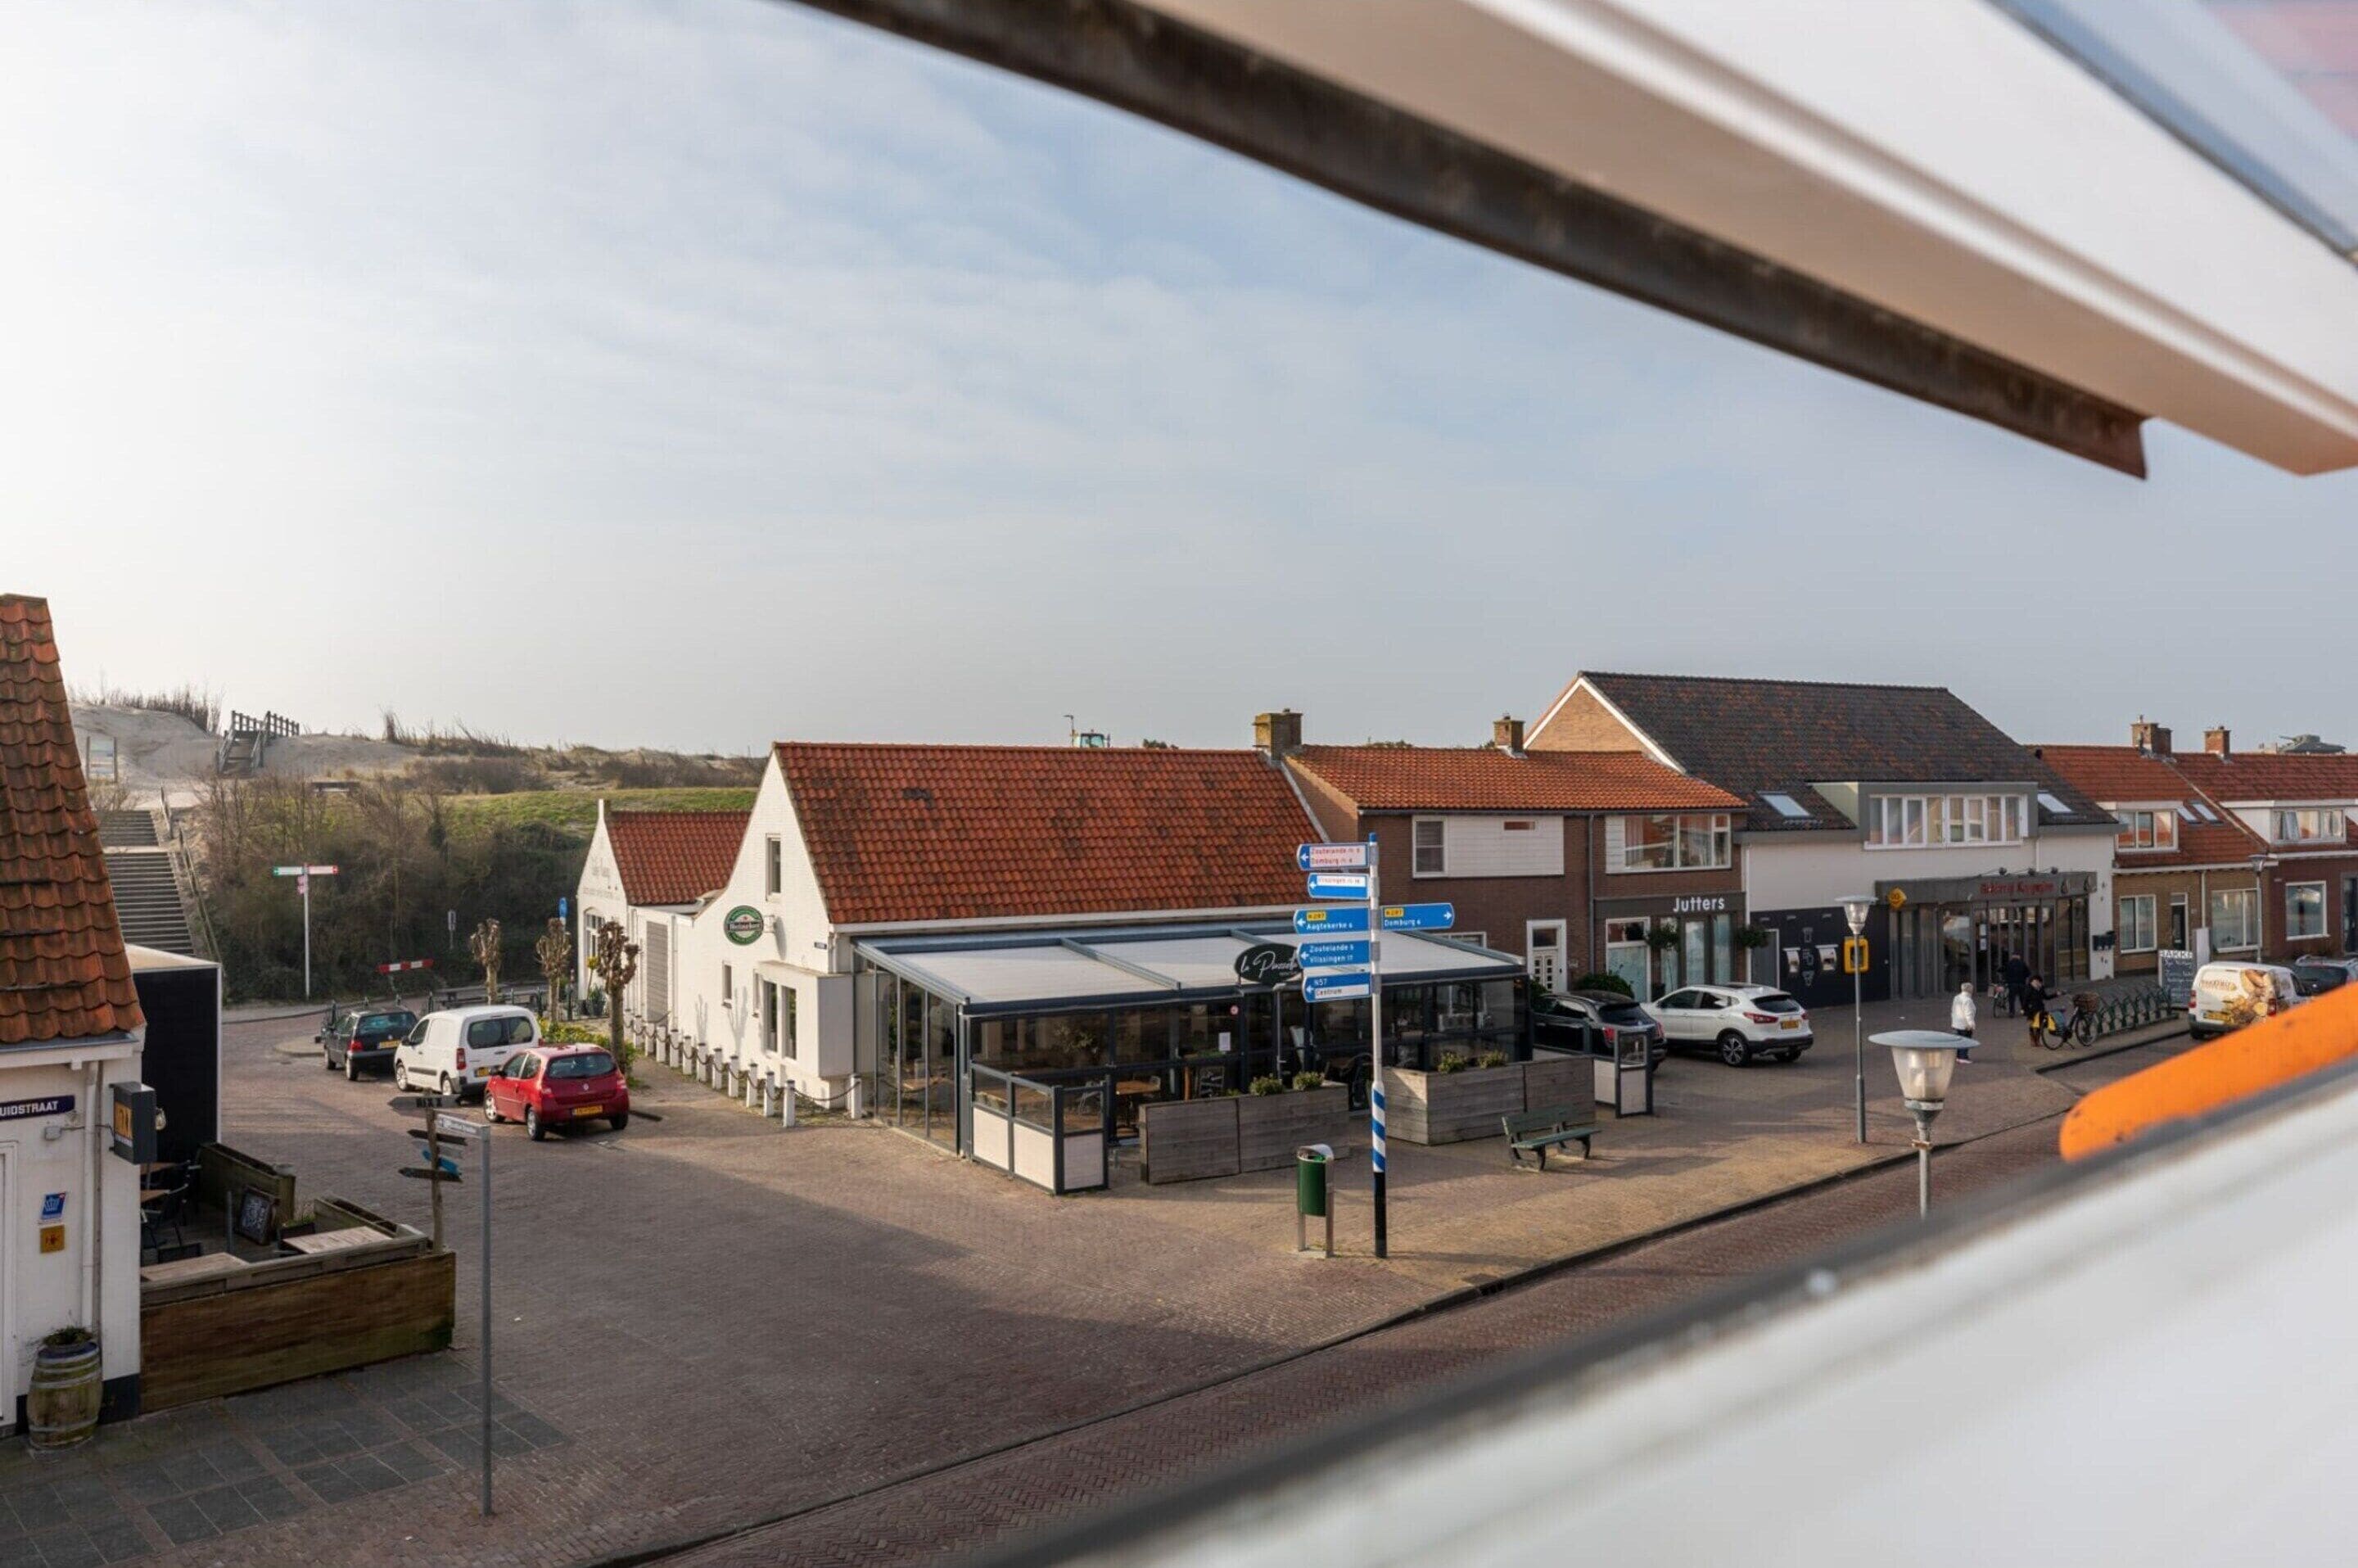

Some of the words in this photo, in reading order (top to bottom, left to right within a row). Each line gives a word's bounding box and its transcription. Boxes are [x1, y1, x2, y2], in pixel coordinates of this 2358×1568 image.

[1673, 897, 1724, 912] Jutters
[1306, 922, 1348, 931] Aagtekerke
[1385, 919, 1416, 927] Domburg
[1309, 944, 1348, 953] Zoutelande
[1309, 955, 1345, 964] Vlissingen
